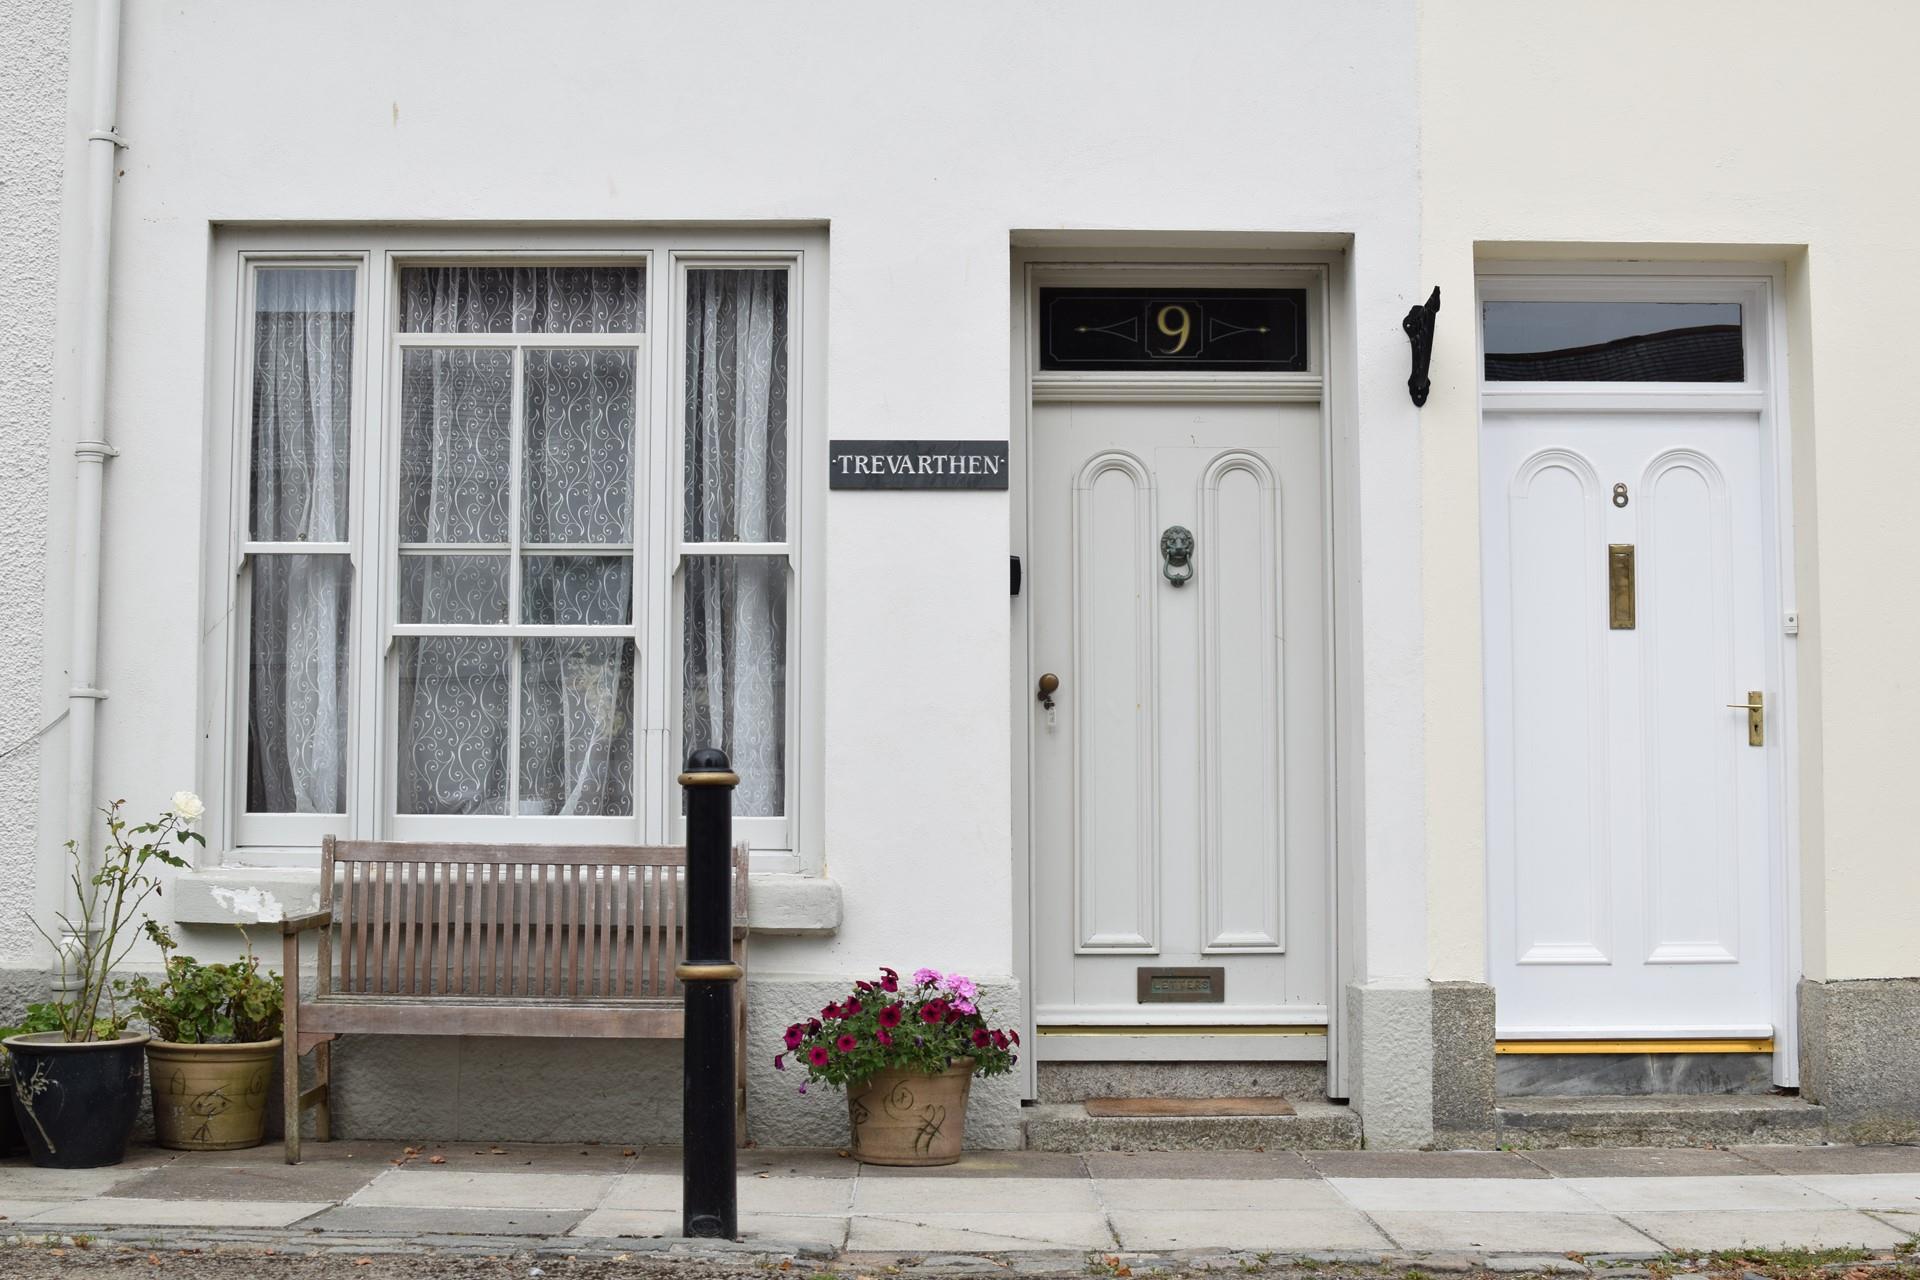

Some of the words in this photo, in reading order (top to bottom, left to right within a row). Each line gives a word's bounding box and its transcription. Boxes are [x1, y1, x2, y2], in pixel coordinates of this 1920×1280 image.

[1158, 305, 1190, 354] 9
[836, 454, 1000, 474] TREVARTHEN
[1612, 482, 1629, 508] 8
[1152, 979, 1209, 991] LETTERS
